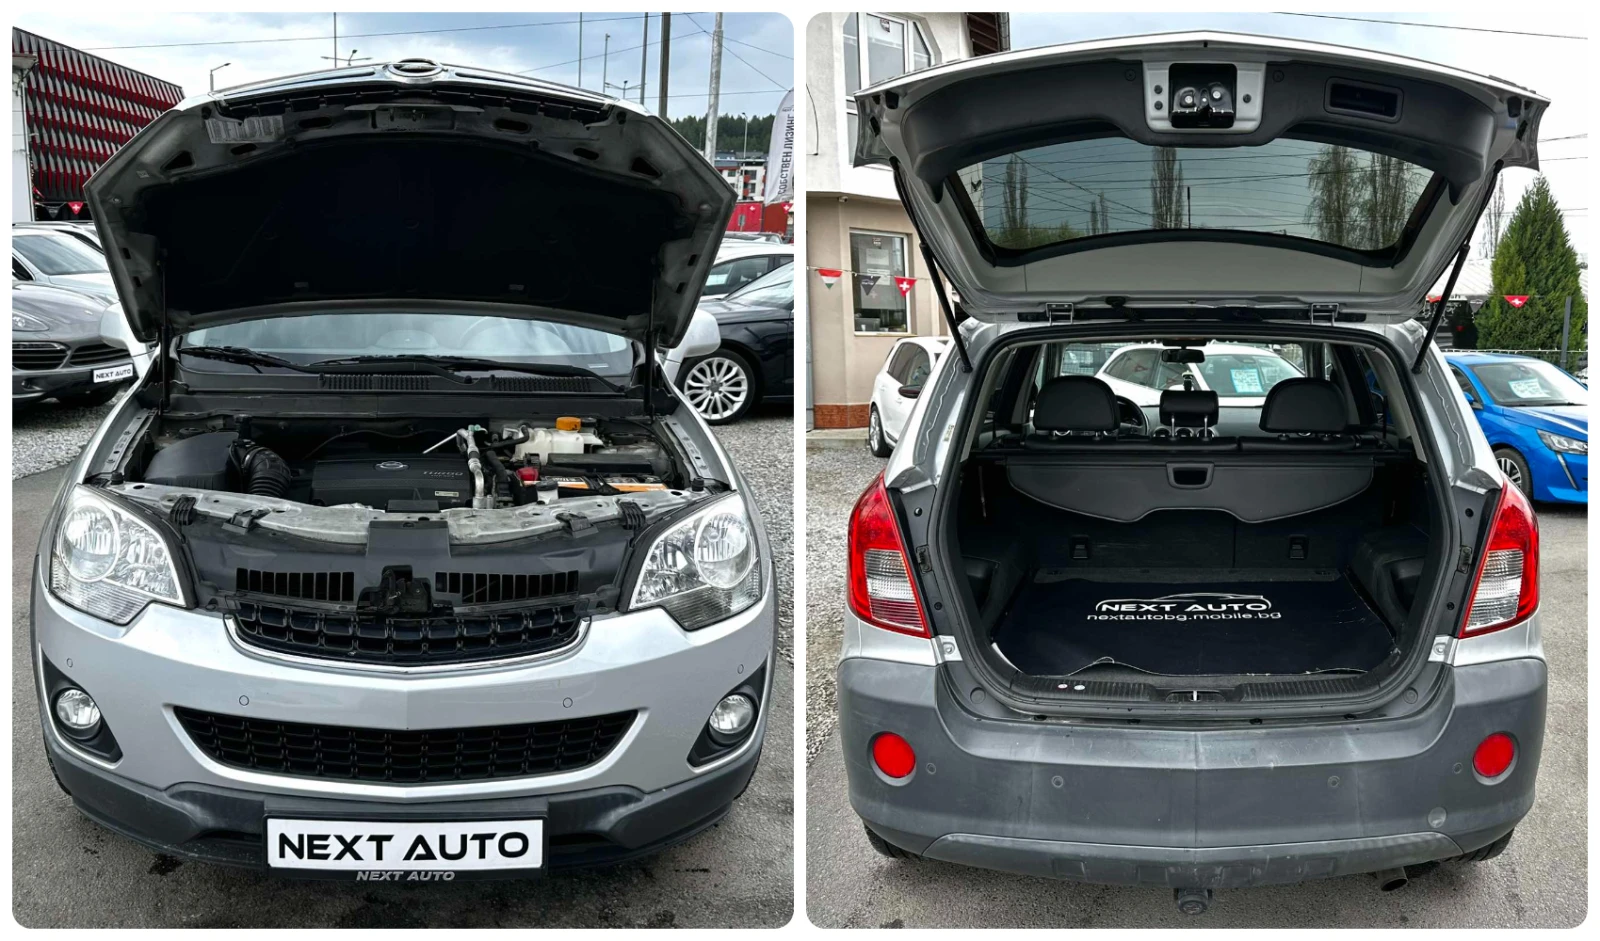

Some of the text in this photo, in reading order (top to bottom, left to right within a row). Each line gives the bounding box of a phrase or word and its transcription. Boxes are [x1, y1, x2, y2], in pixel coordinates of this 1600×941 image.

[778, 151, 792, 195] СОБСТВЕН
[96, 369, 132, 379] NEXT AUTO
[1101, 603, 1268, 612] NEXT AUTO
[1087, 612, 1282, 621] nextautobg.mobile.bg
[278, 831, 530, 861] NEXT AUTO
[356, 871, 456, 881] NEXT AUTO
